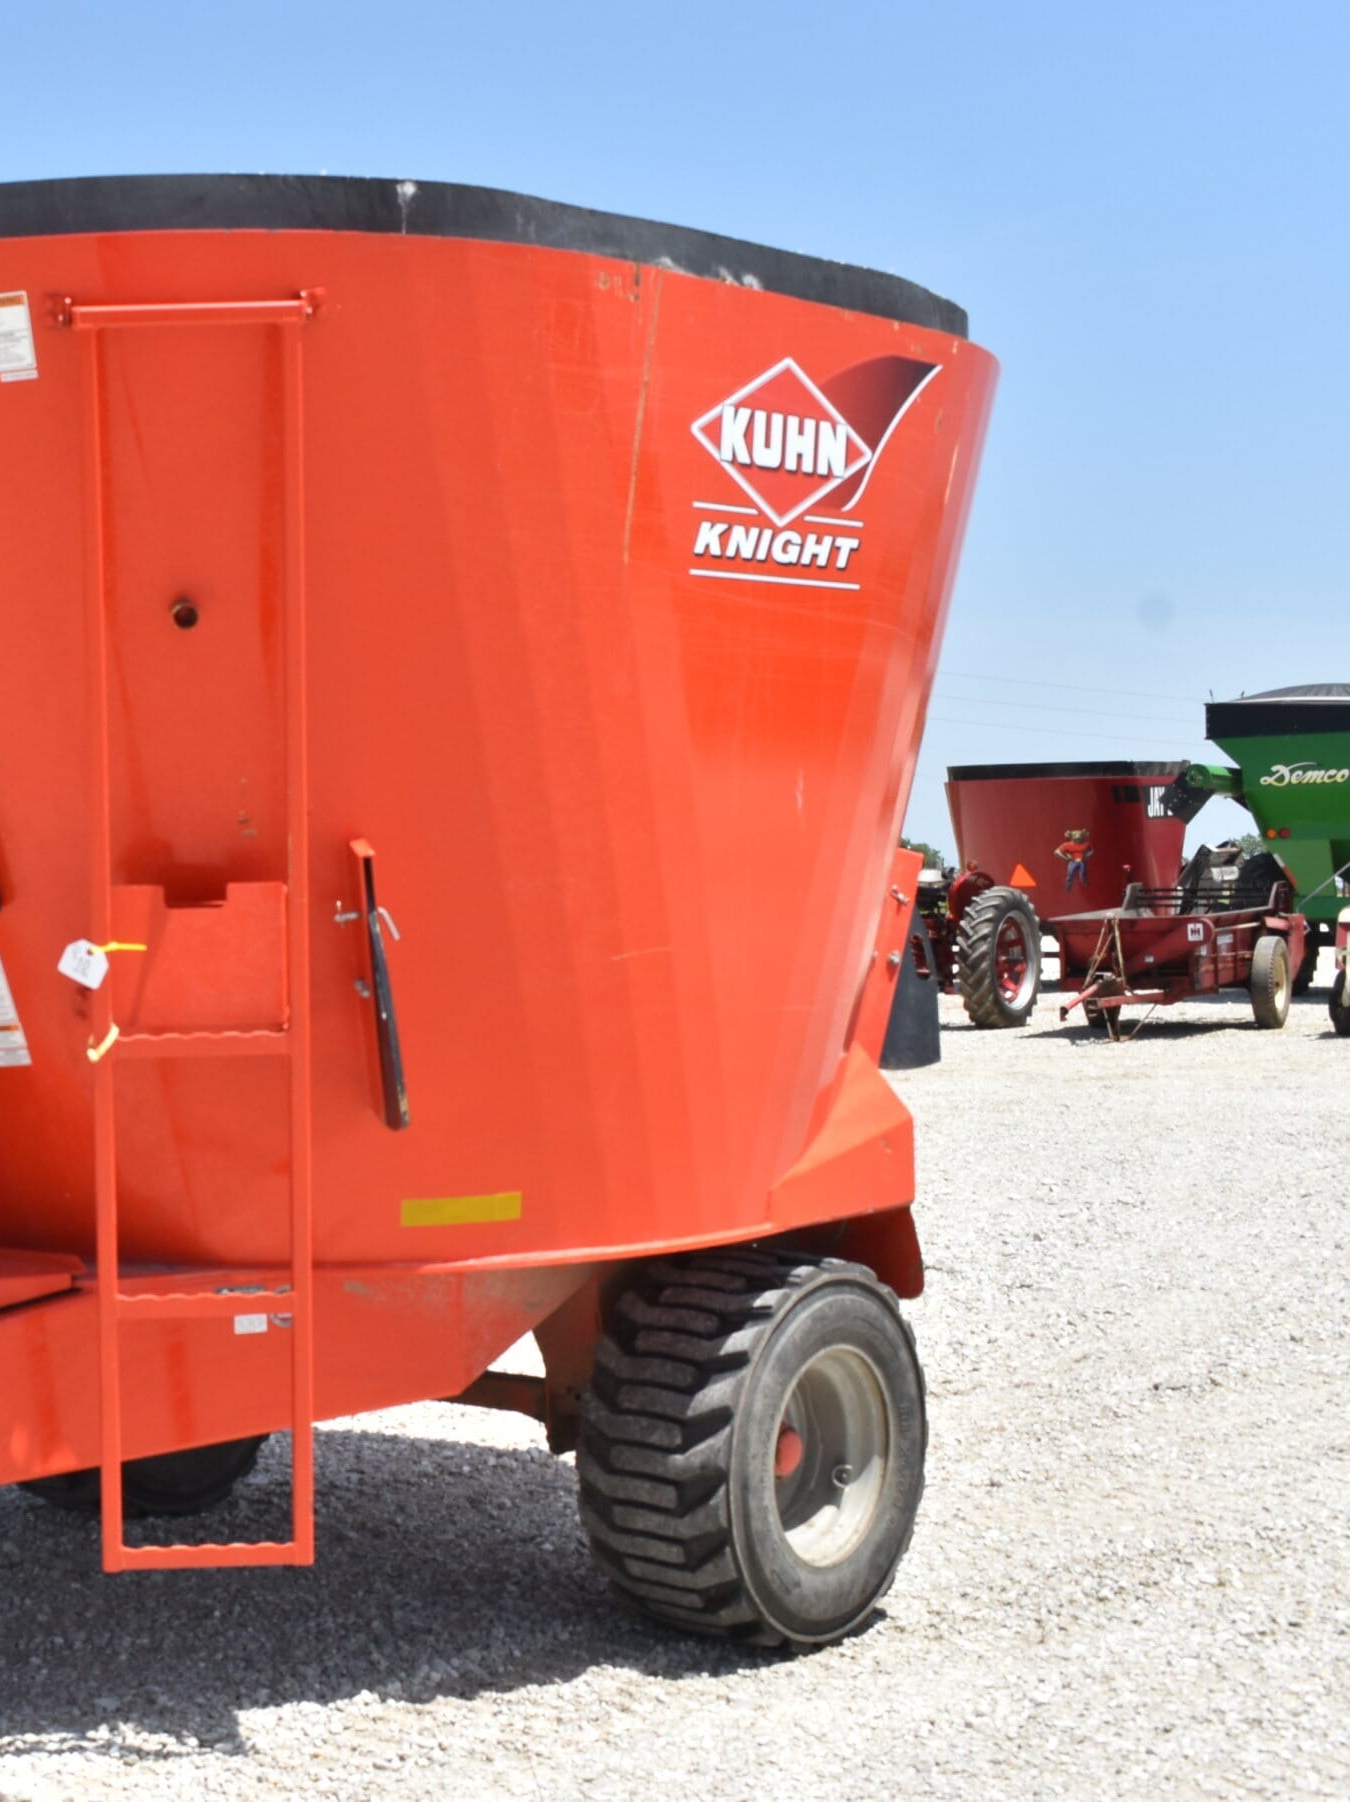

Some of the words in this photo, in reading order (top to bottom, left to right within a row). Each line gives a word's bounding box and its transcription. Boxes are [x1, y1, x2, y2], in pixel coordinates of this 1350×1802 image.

[720, 404, 848, 479] KUHN
[693, 521, 860, 569] KNIGHT
[1259, 761, 1350, 787] Demco
